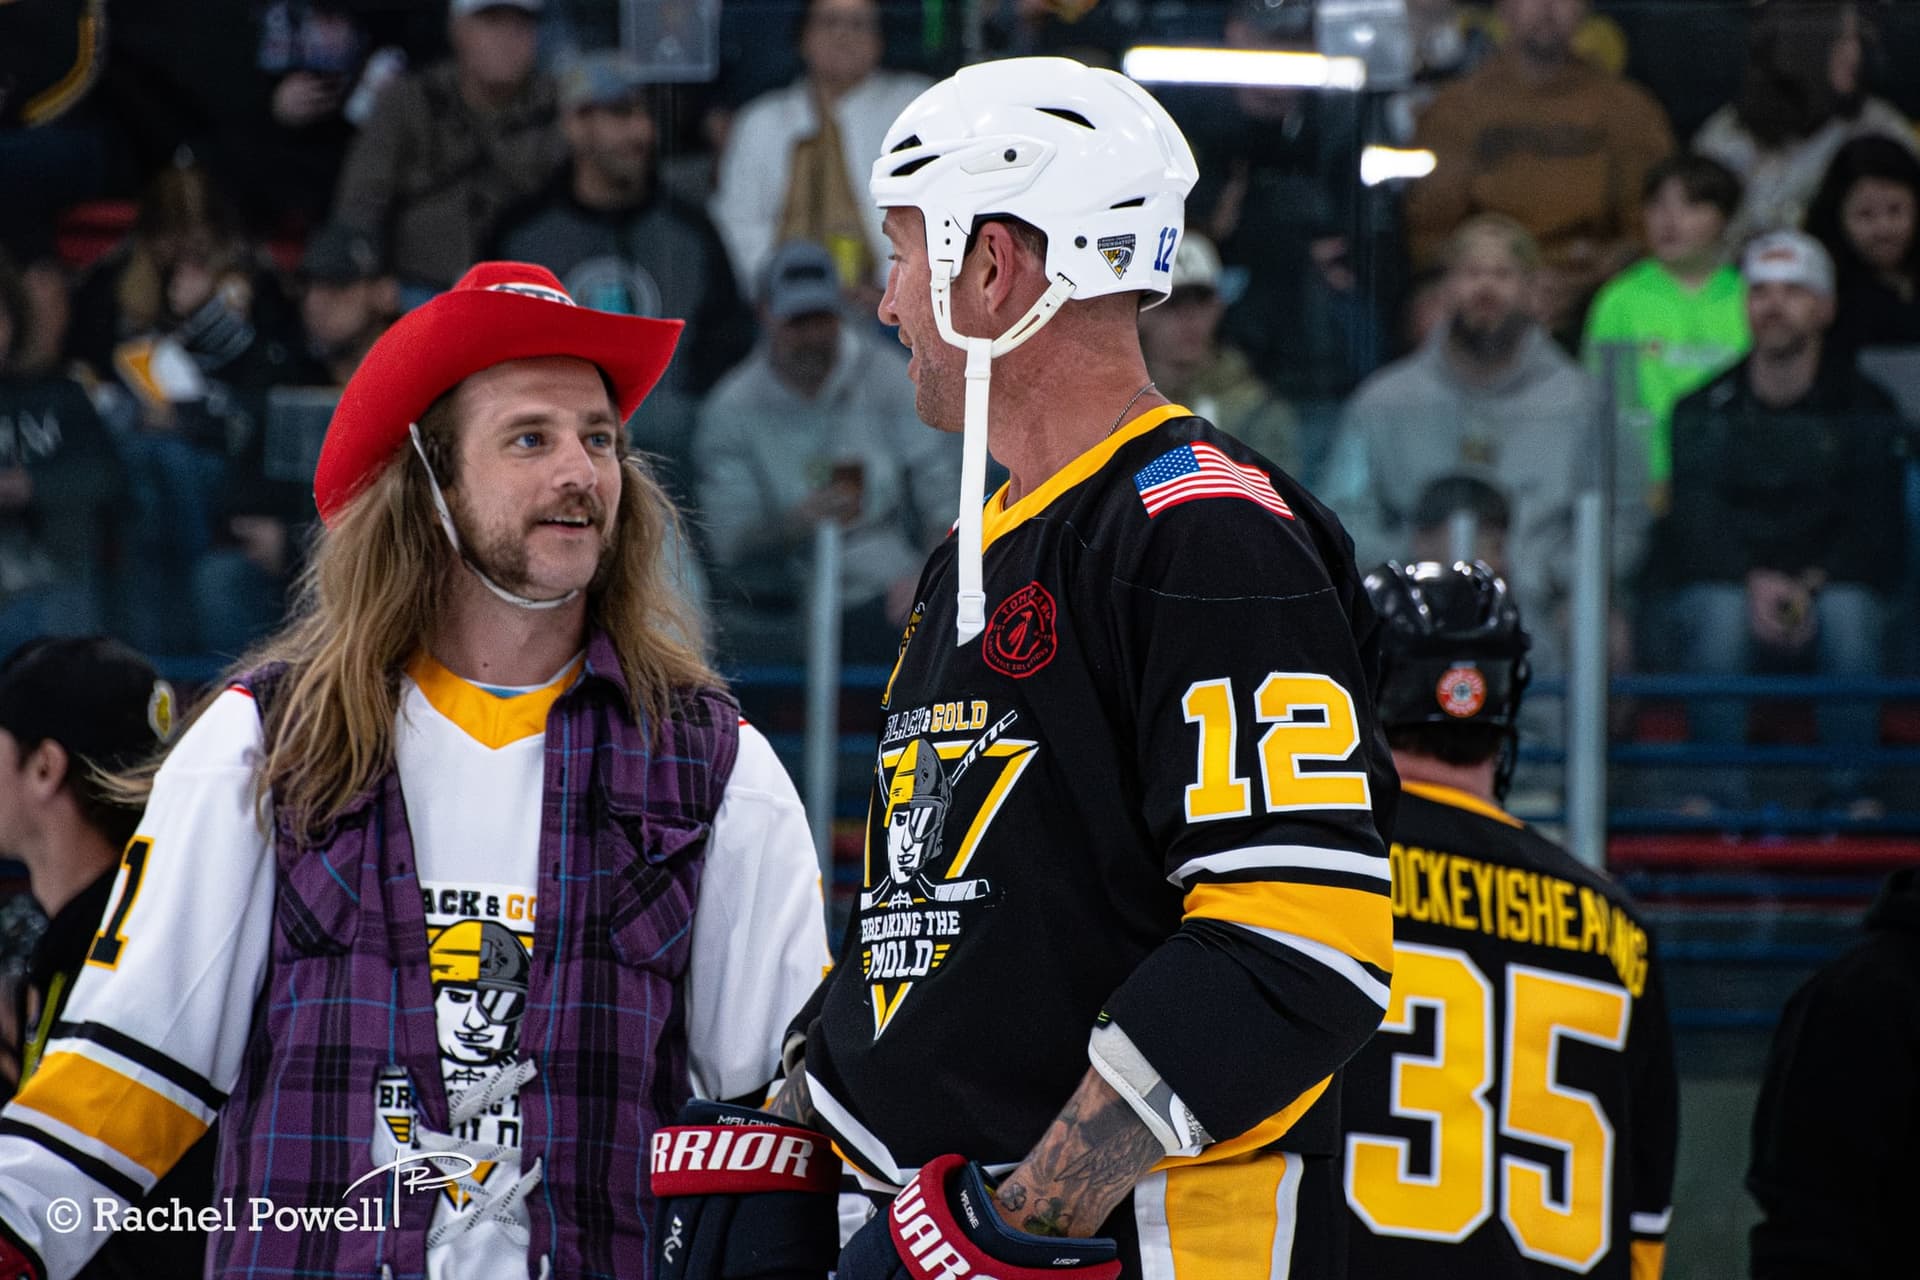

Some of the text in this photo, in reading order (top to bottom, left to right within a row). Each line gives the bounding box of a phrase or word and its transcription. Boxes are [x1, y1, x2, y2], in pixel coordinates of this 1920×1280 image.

[1153, 226, 1178, 273] 12
[930, 700, 989, 733] GOLD
[1181, 671, 1373, 824] 12
[486, 895, 500, 917] &
[861, 911, 960, 944] BREAKING THE
[865, 939, 934, 981] MOLD
[1344, 940, 1632, 1273] 35
[893, 1173, 1002, 1280] WAR
